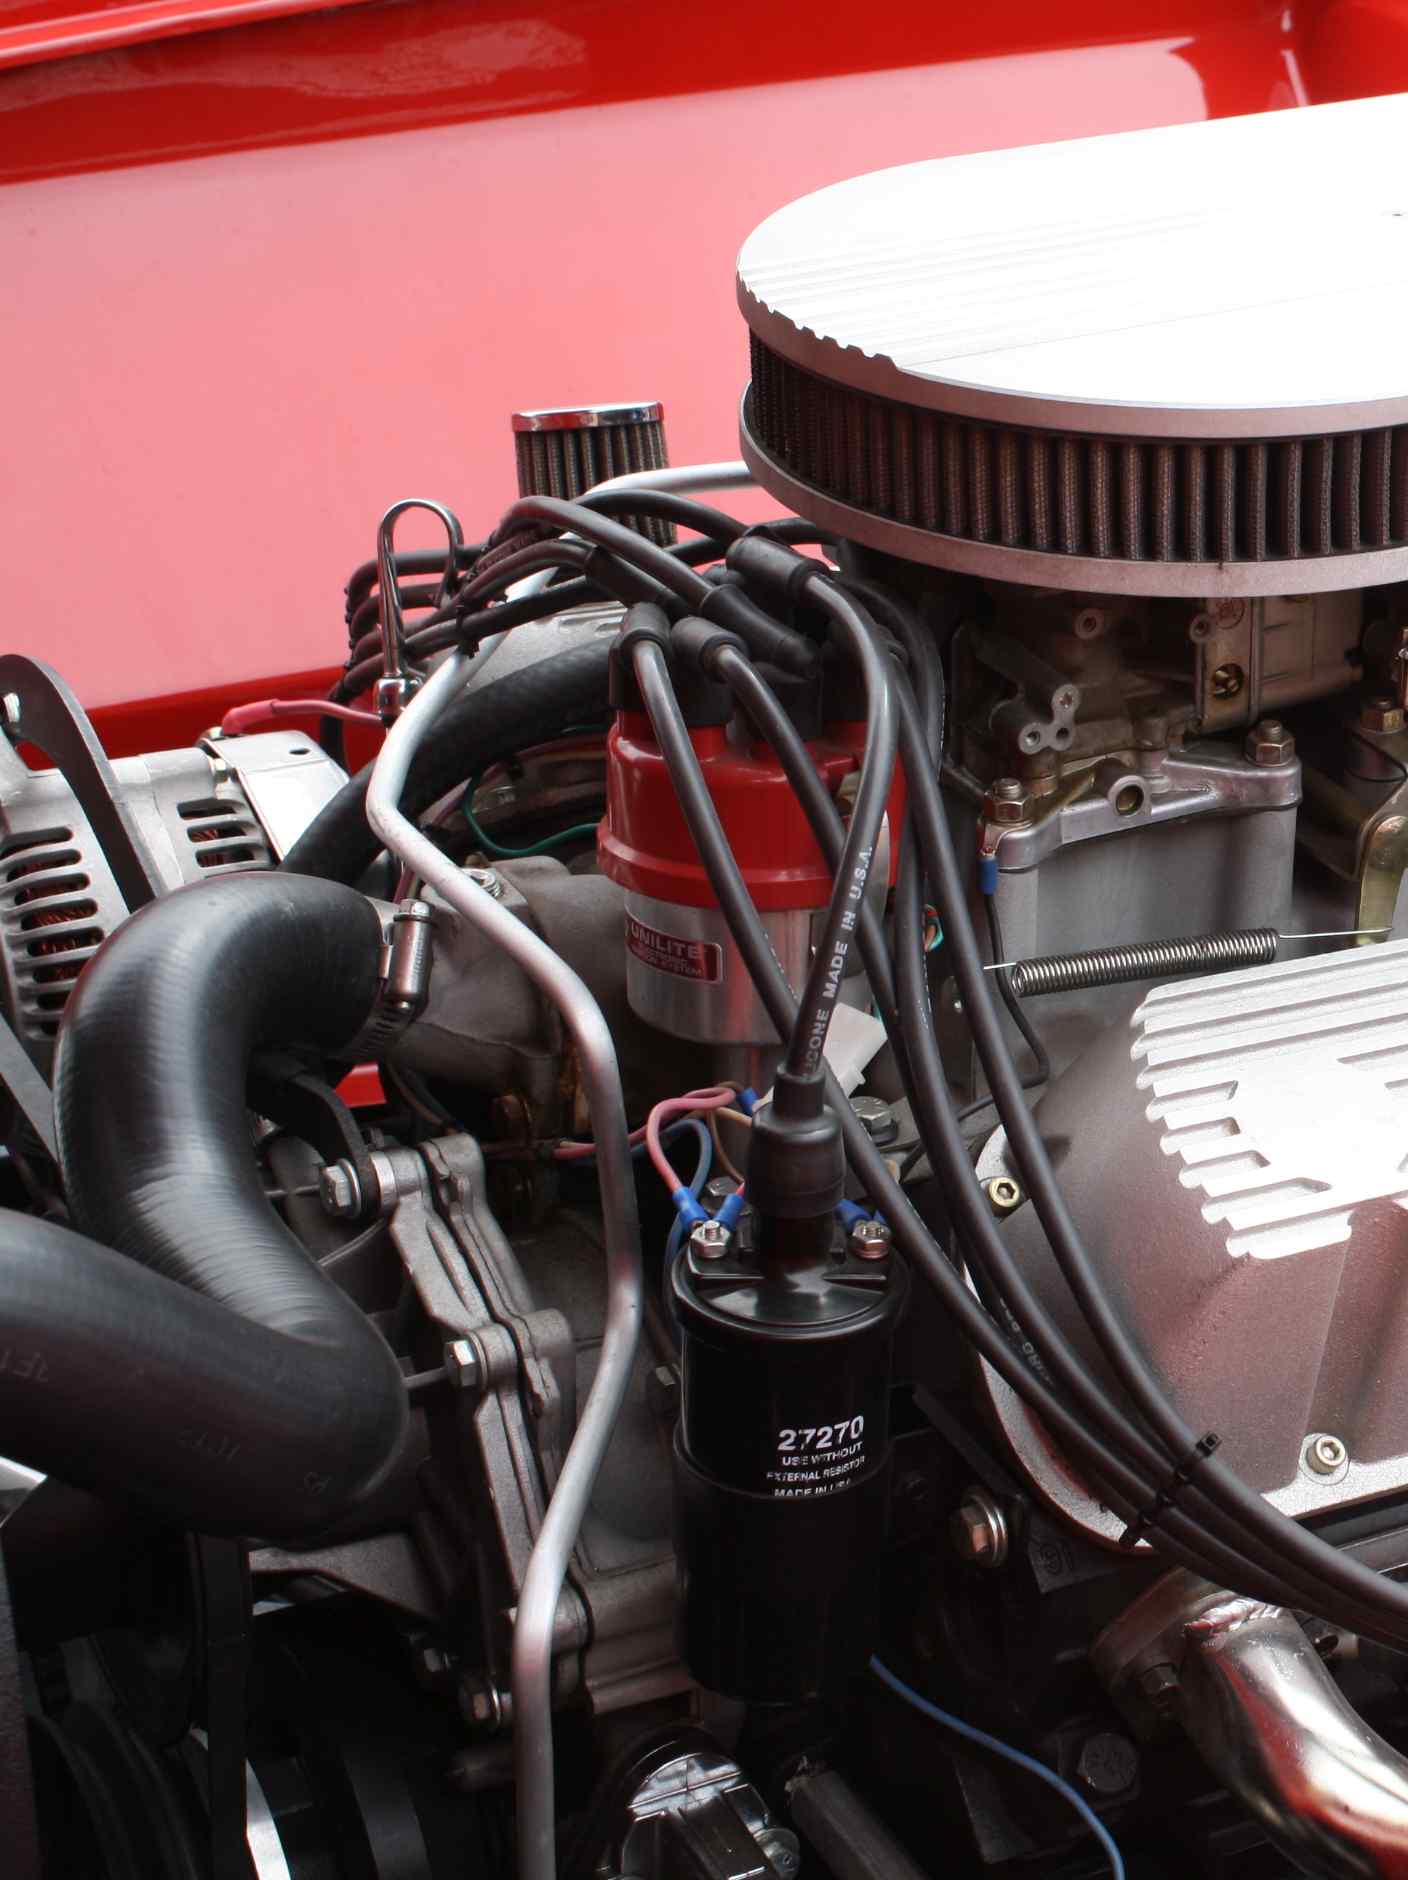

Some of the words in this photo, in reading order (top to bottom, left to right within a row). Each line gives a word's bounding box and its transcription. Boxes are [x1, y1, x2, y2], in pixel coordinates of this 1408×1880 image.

[822, 940, 849, 998] MADE
[841, 910, 857, 932] IN
[849, 846, 874, 900] U.S.A.
[631, 922, 701, 959] UNILITE
[777, 1415, 865, 1451] 27270
[782, 1456, 809, 1467] USE
[811, 1440, 864, 1465] WITHOUT
